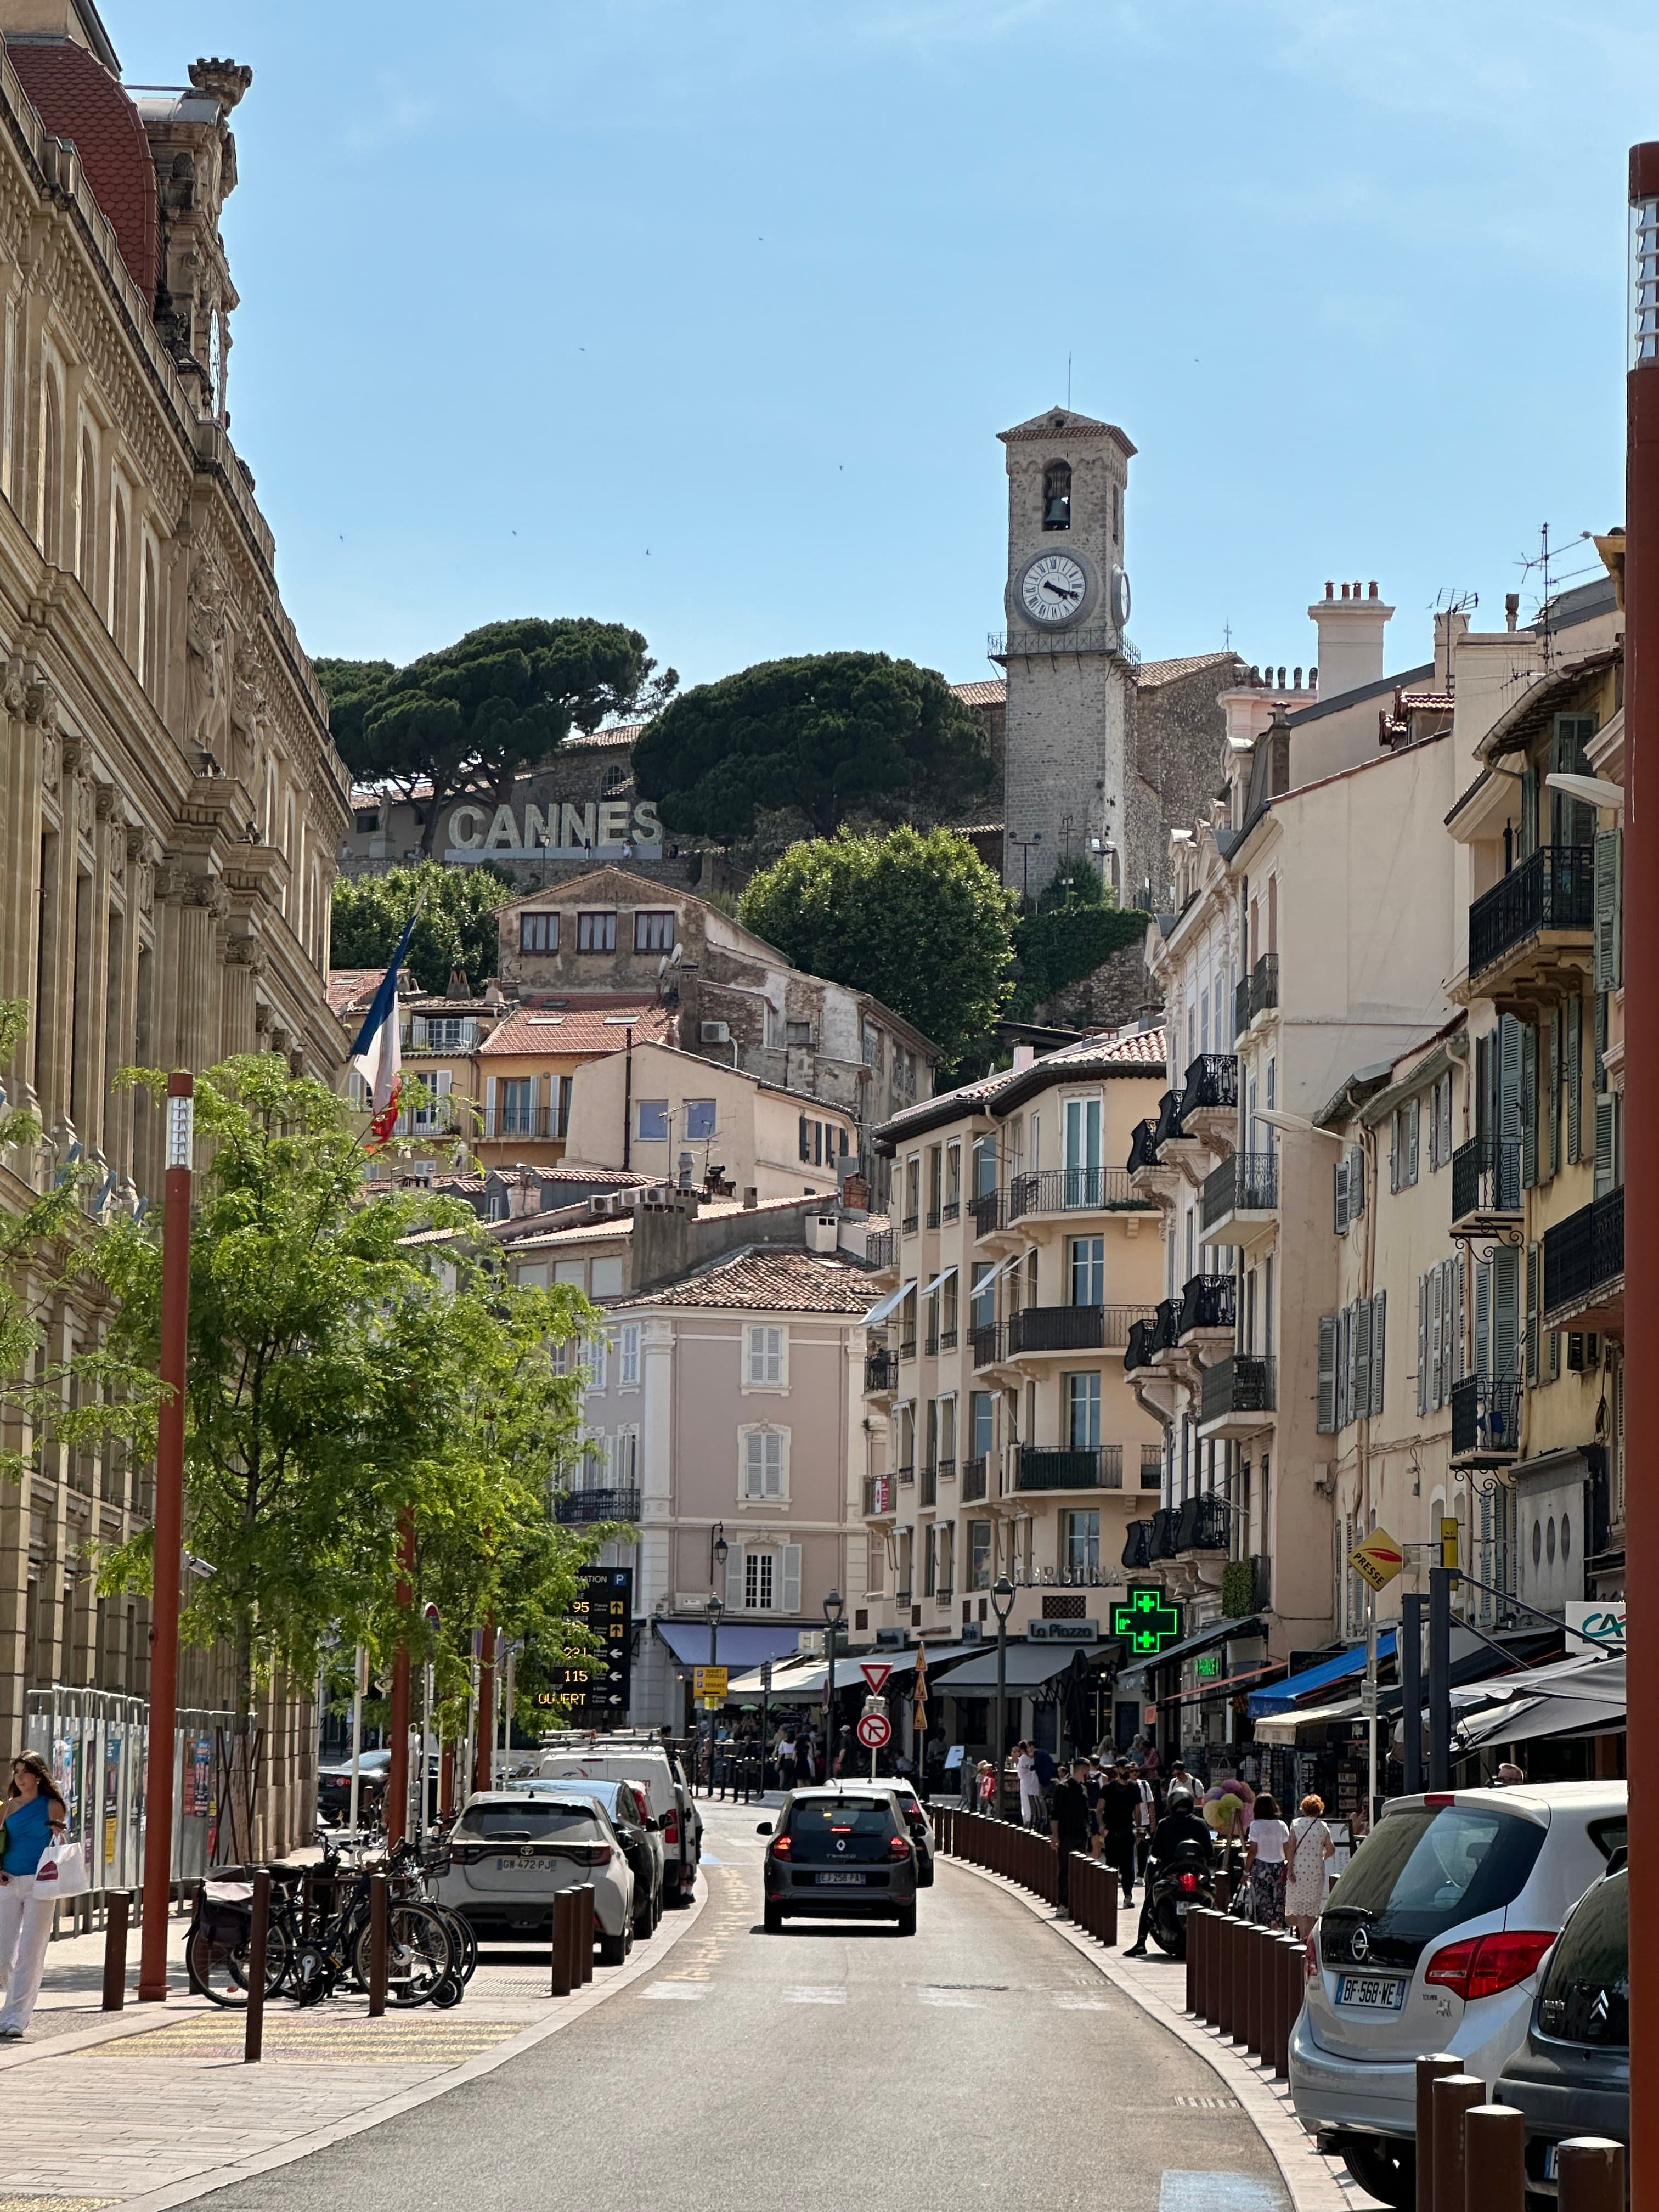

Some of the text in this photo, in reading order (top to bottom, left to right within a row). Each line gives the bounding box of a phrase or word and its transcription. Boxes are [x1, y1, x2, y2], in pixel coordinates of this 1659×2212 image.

[449, 801, 664, 850] CANNES
[1353, 1552, 1385, 1587] PRESSE
[1030, 1623, 1092, 1638] La Piazza
[565, 1669, 589, 1683] 115
